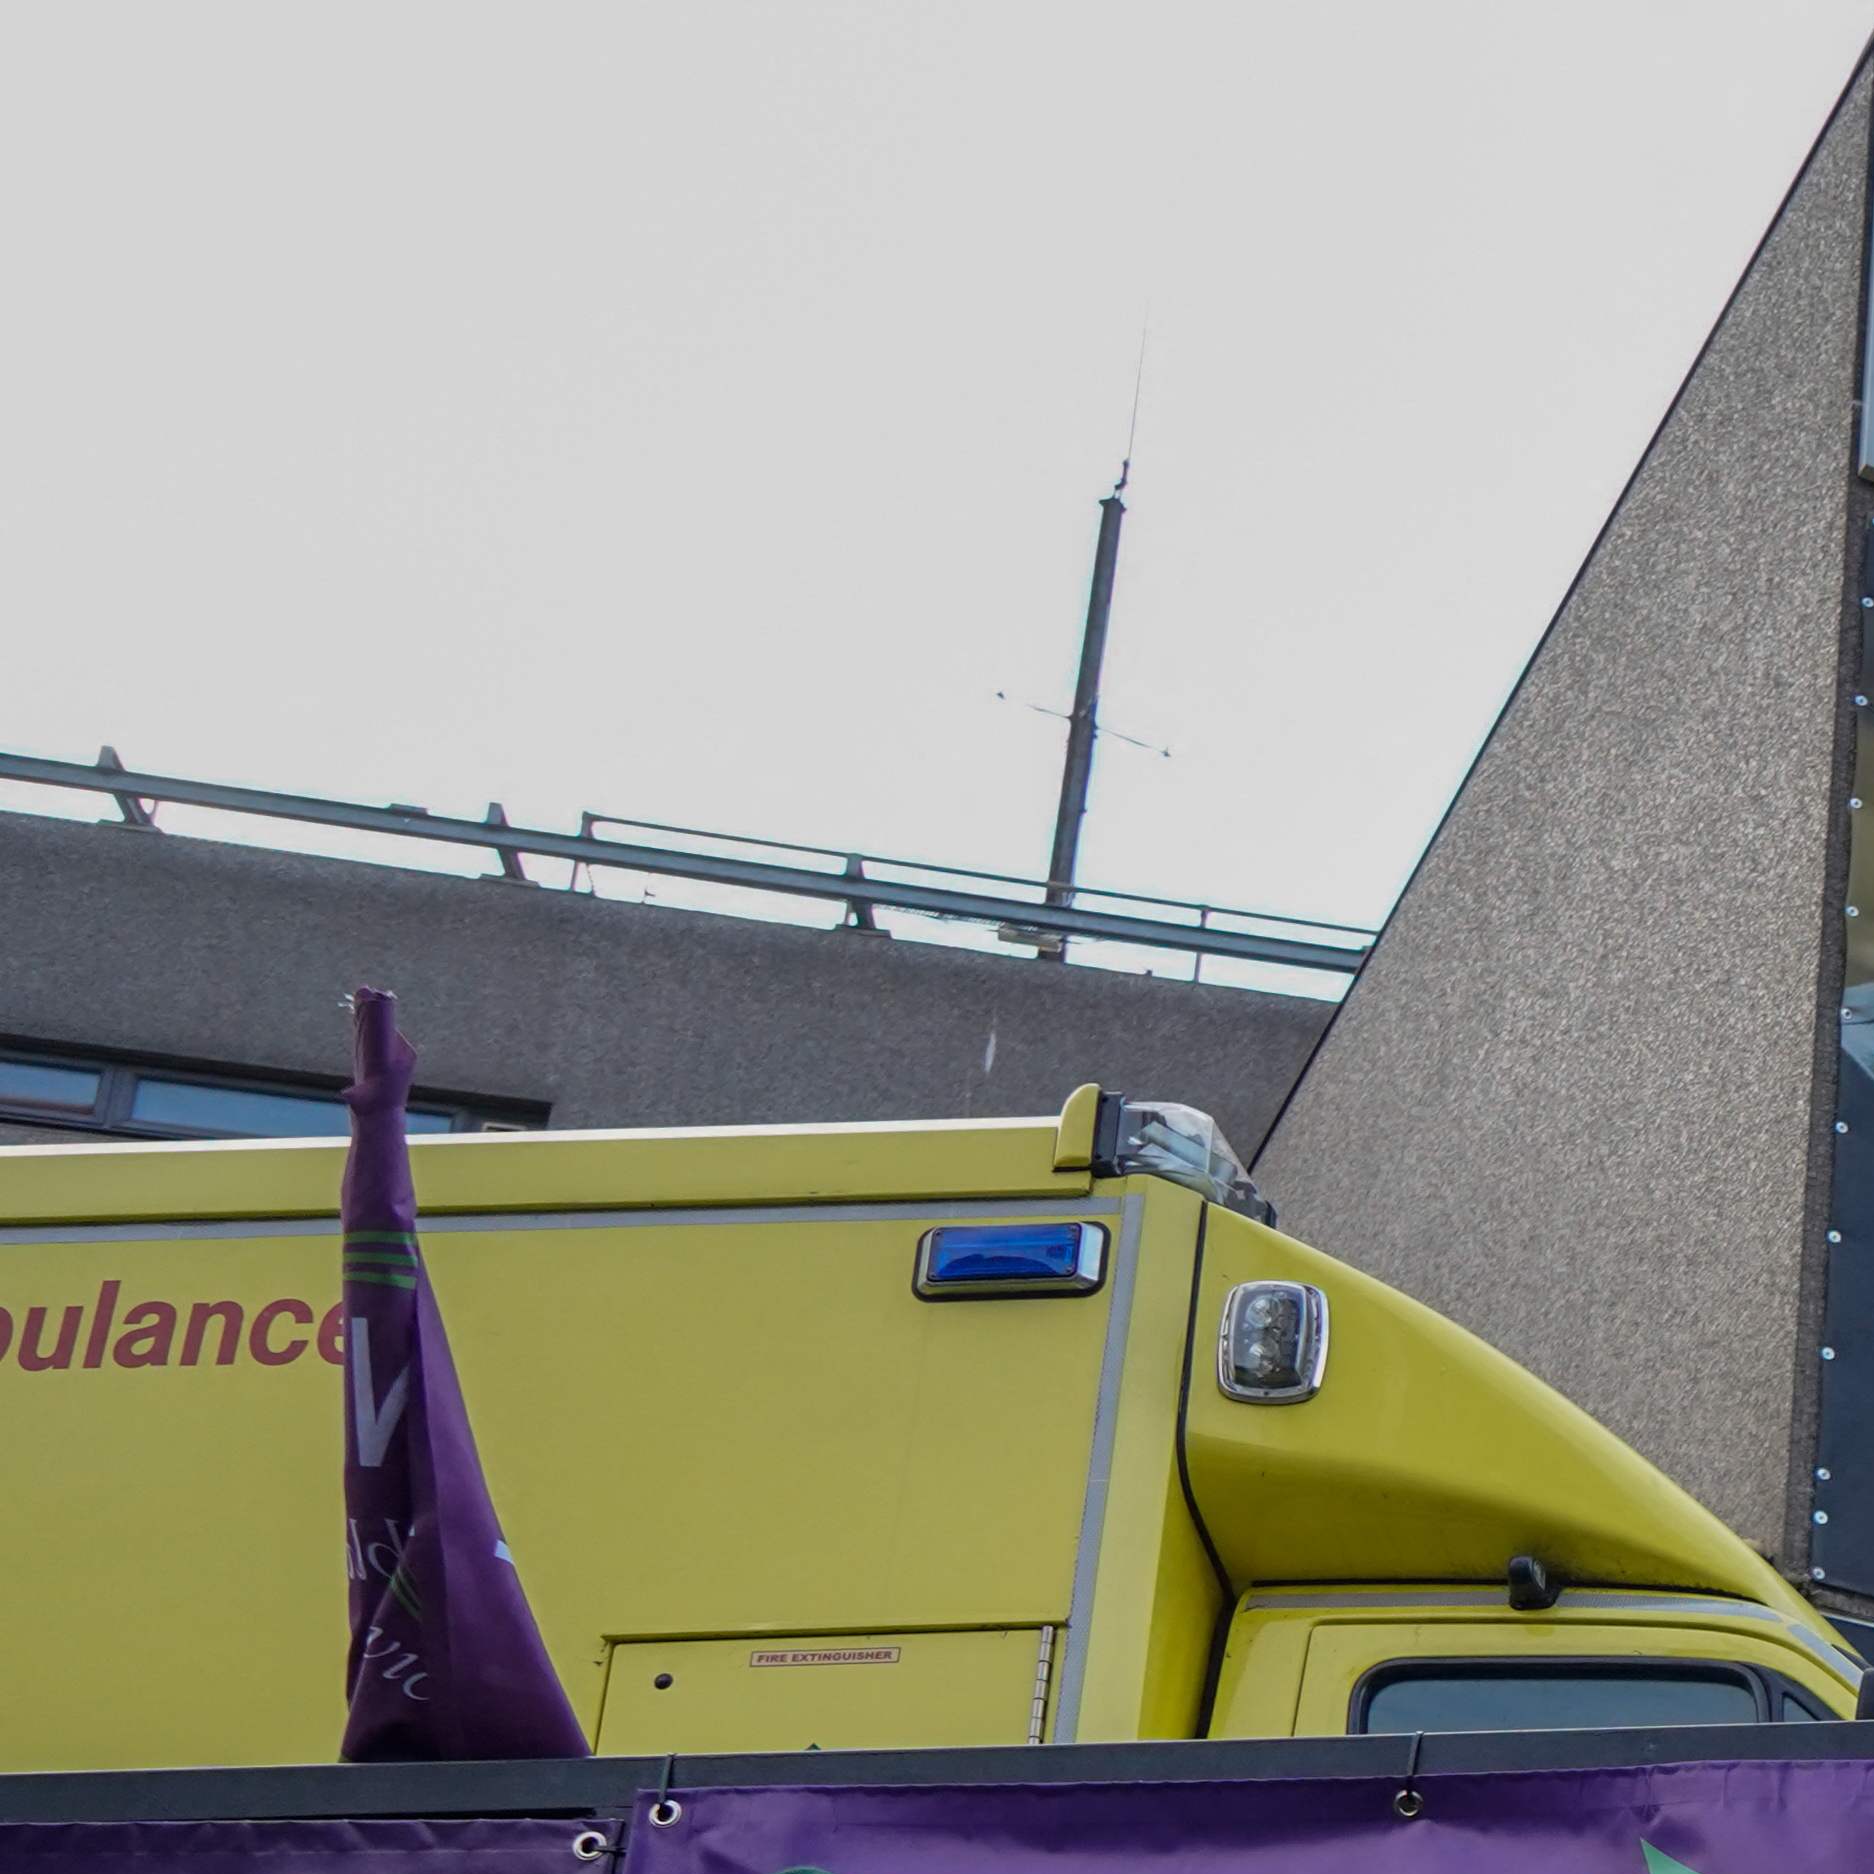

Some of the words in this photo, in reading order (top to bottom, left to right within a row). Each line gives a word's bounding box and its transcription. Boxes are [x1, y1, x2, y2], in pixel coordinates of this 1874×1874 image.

[0, 1279, 343, 1371] ulanc
[756, 1653, 787, 1663] FIRE
[791, 1650, 892, 1663] EXTINGUISHER
